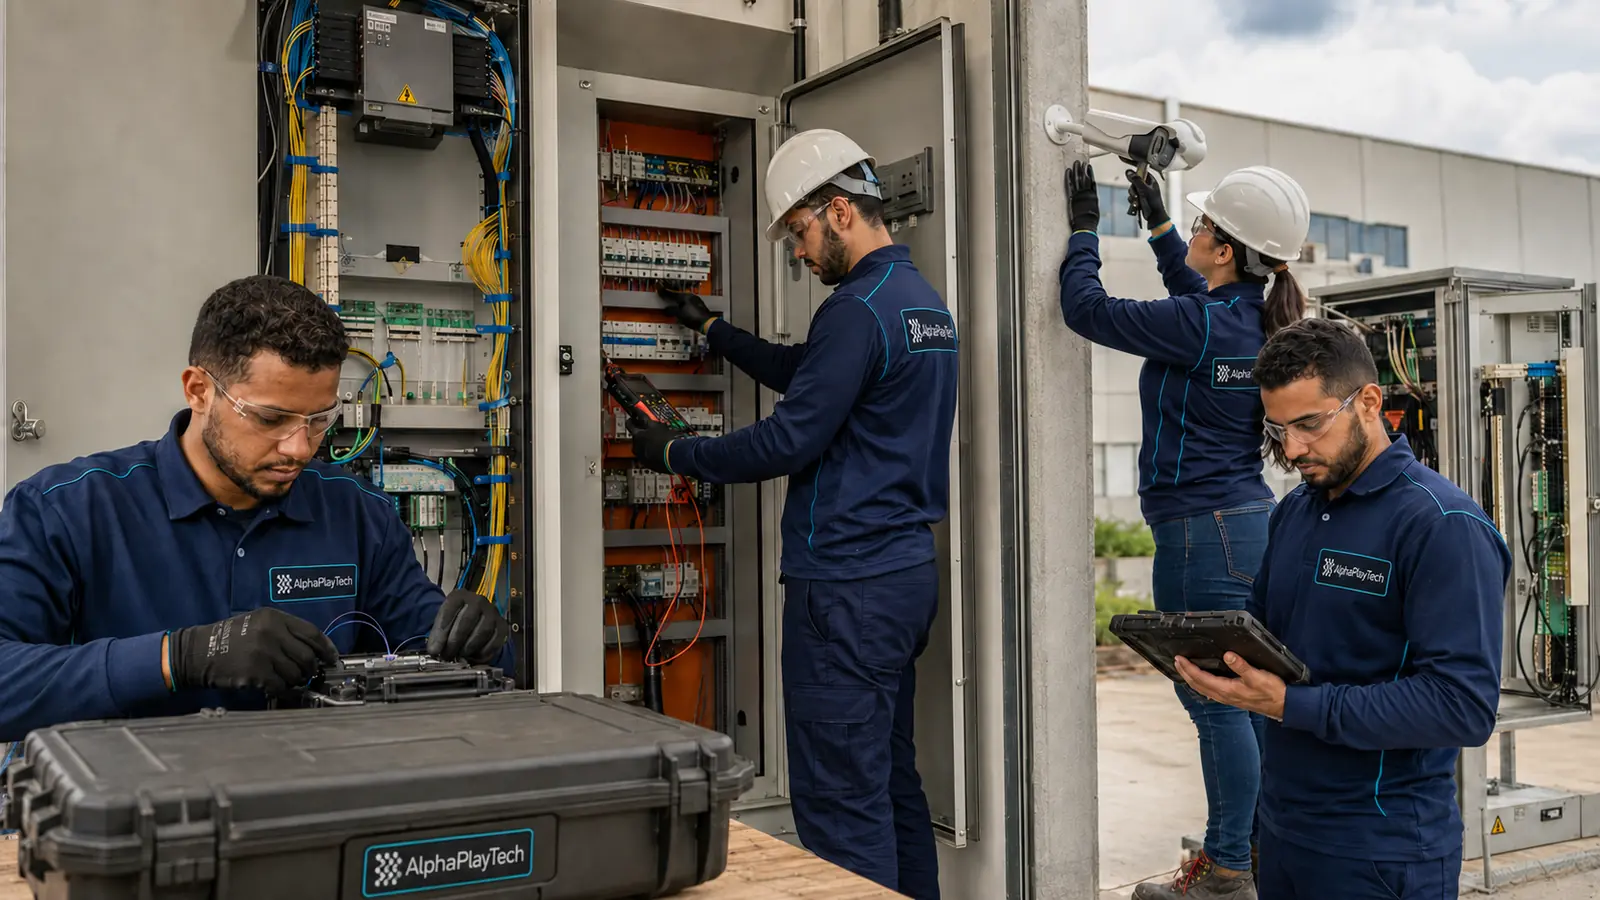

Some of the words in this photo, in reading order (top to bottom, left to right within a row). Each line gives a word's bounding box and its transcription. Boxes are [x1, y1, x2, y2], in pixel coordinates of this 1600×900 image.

[293, 576, 353, 590] AlphaPlayTech
[1333, 564, 1385, 583] AlphaPlayTech
[404, 844, 525, 879] AlphaPlayTech
